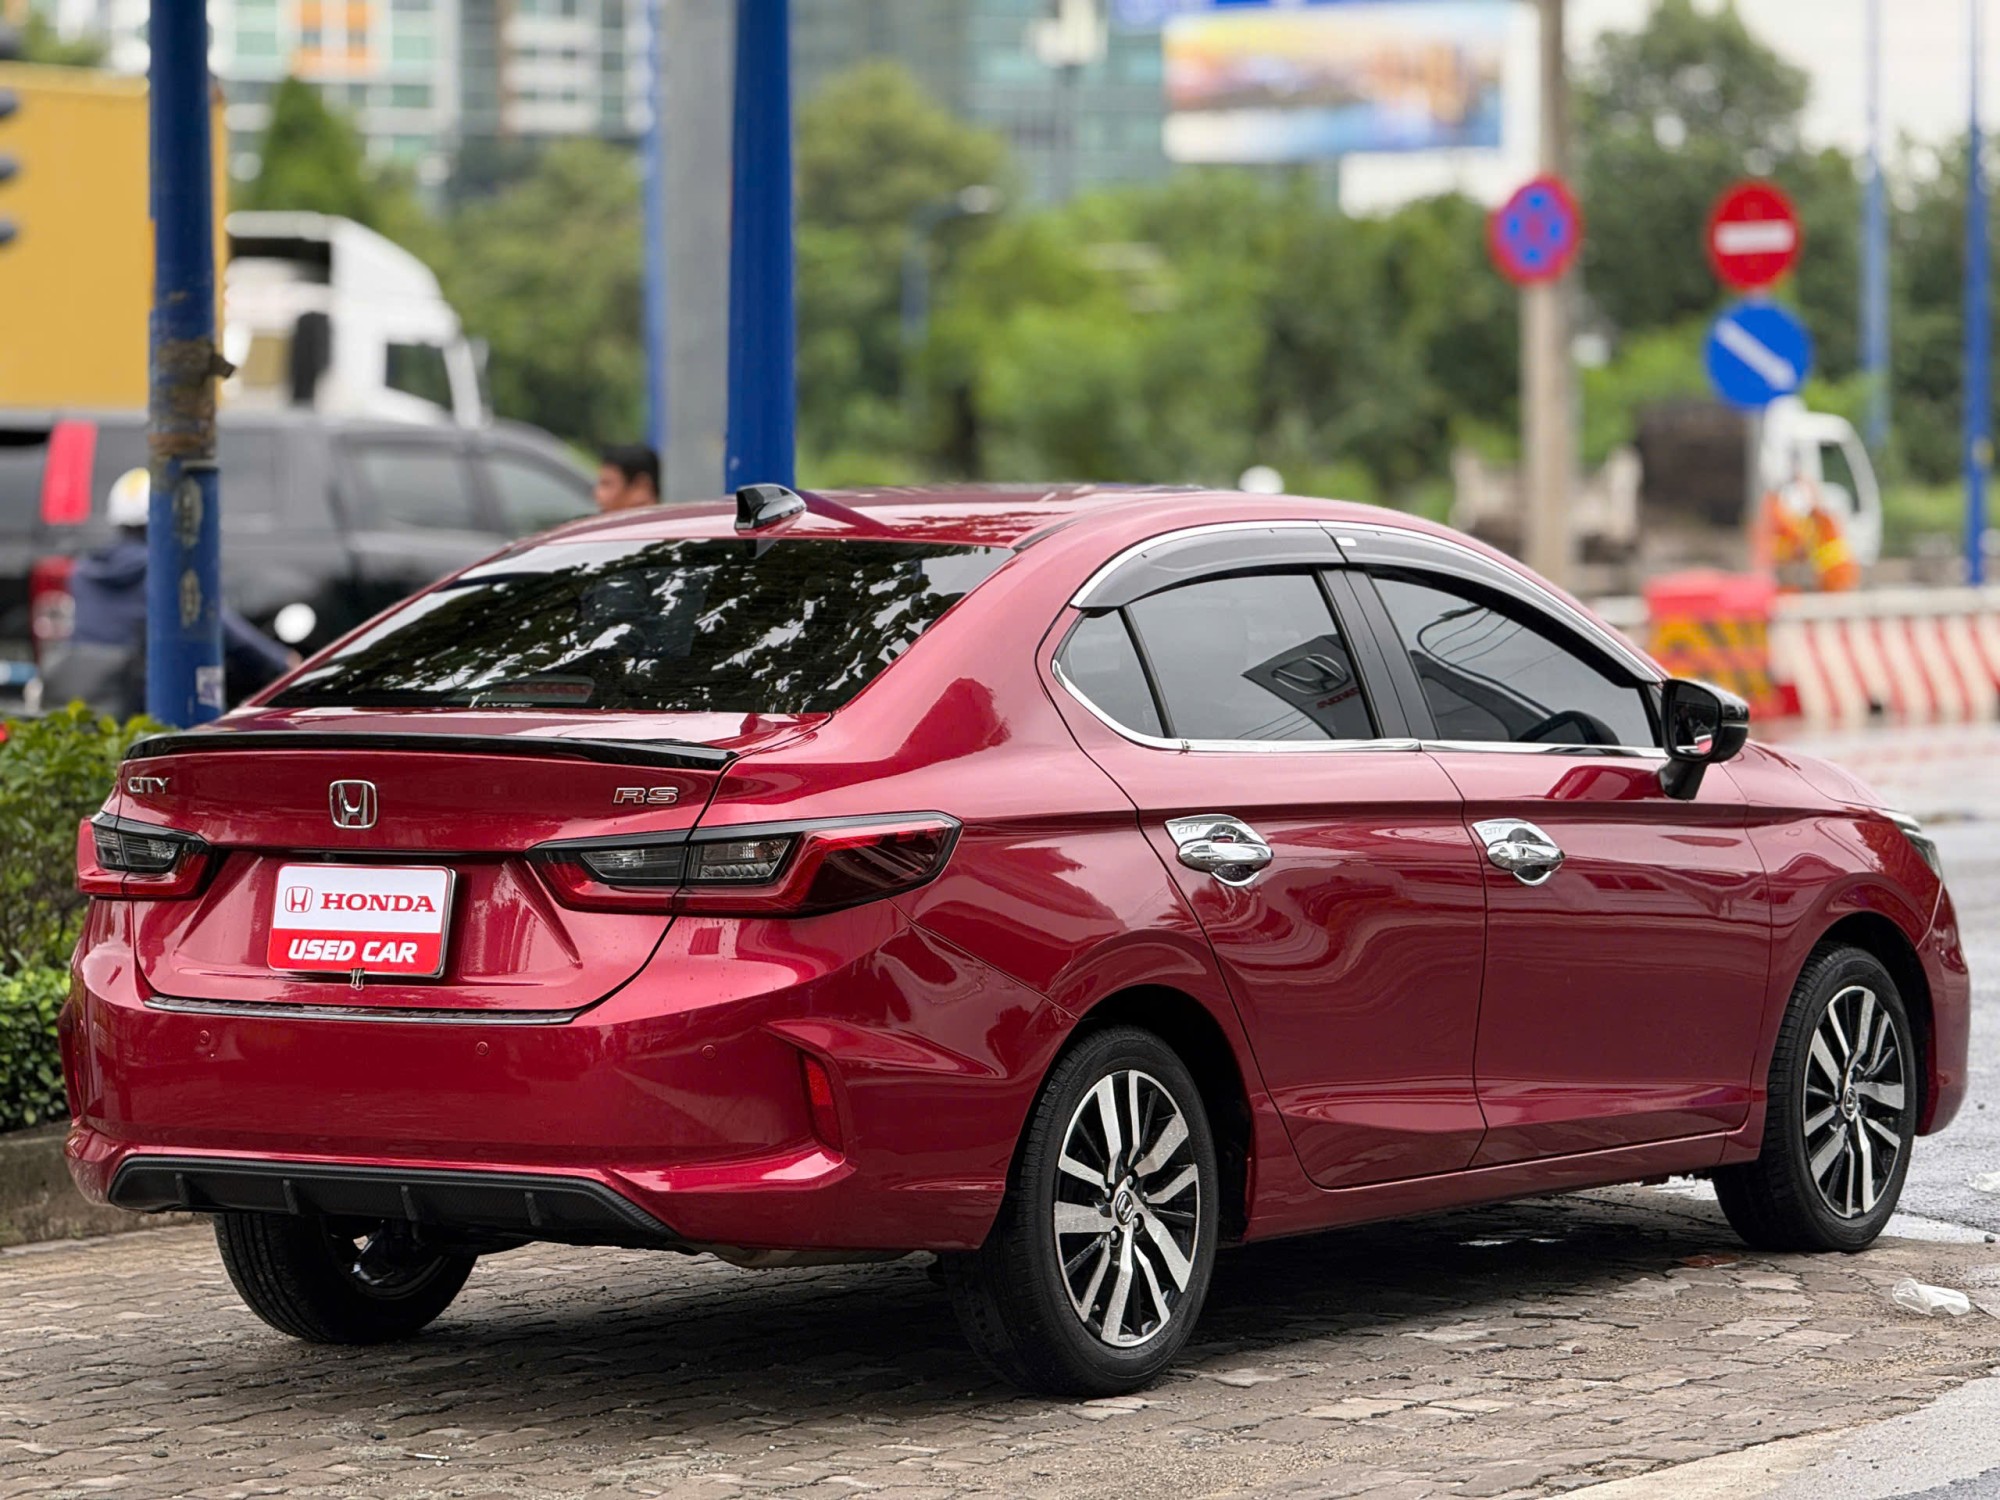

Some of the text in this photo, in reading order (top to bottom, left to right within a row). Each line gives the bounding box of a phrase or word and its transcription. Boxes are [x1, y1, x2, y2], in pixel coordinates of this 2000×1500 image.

[127, 776, 172, 794] CITY
[612, 786, 679, 804] RS
[1177, 823, 1201, 835] CITY
[320, 892, 437, 913] HONDA
[287, 938, 418, 963] USED CAR
